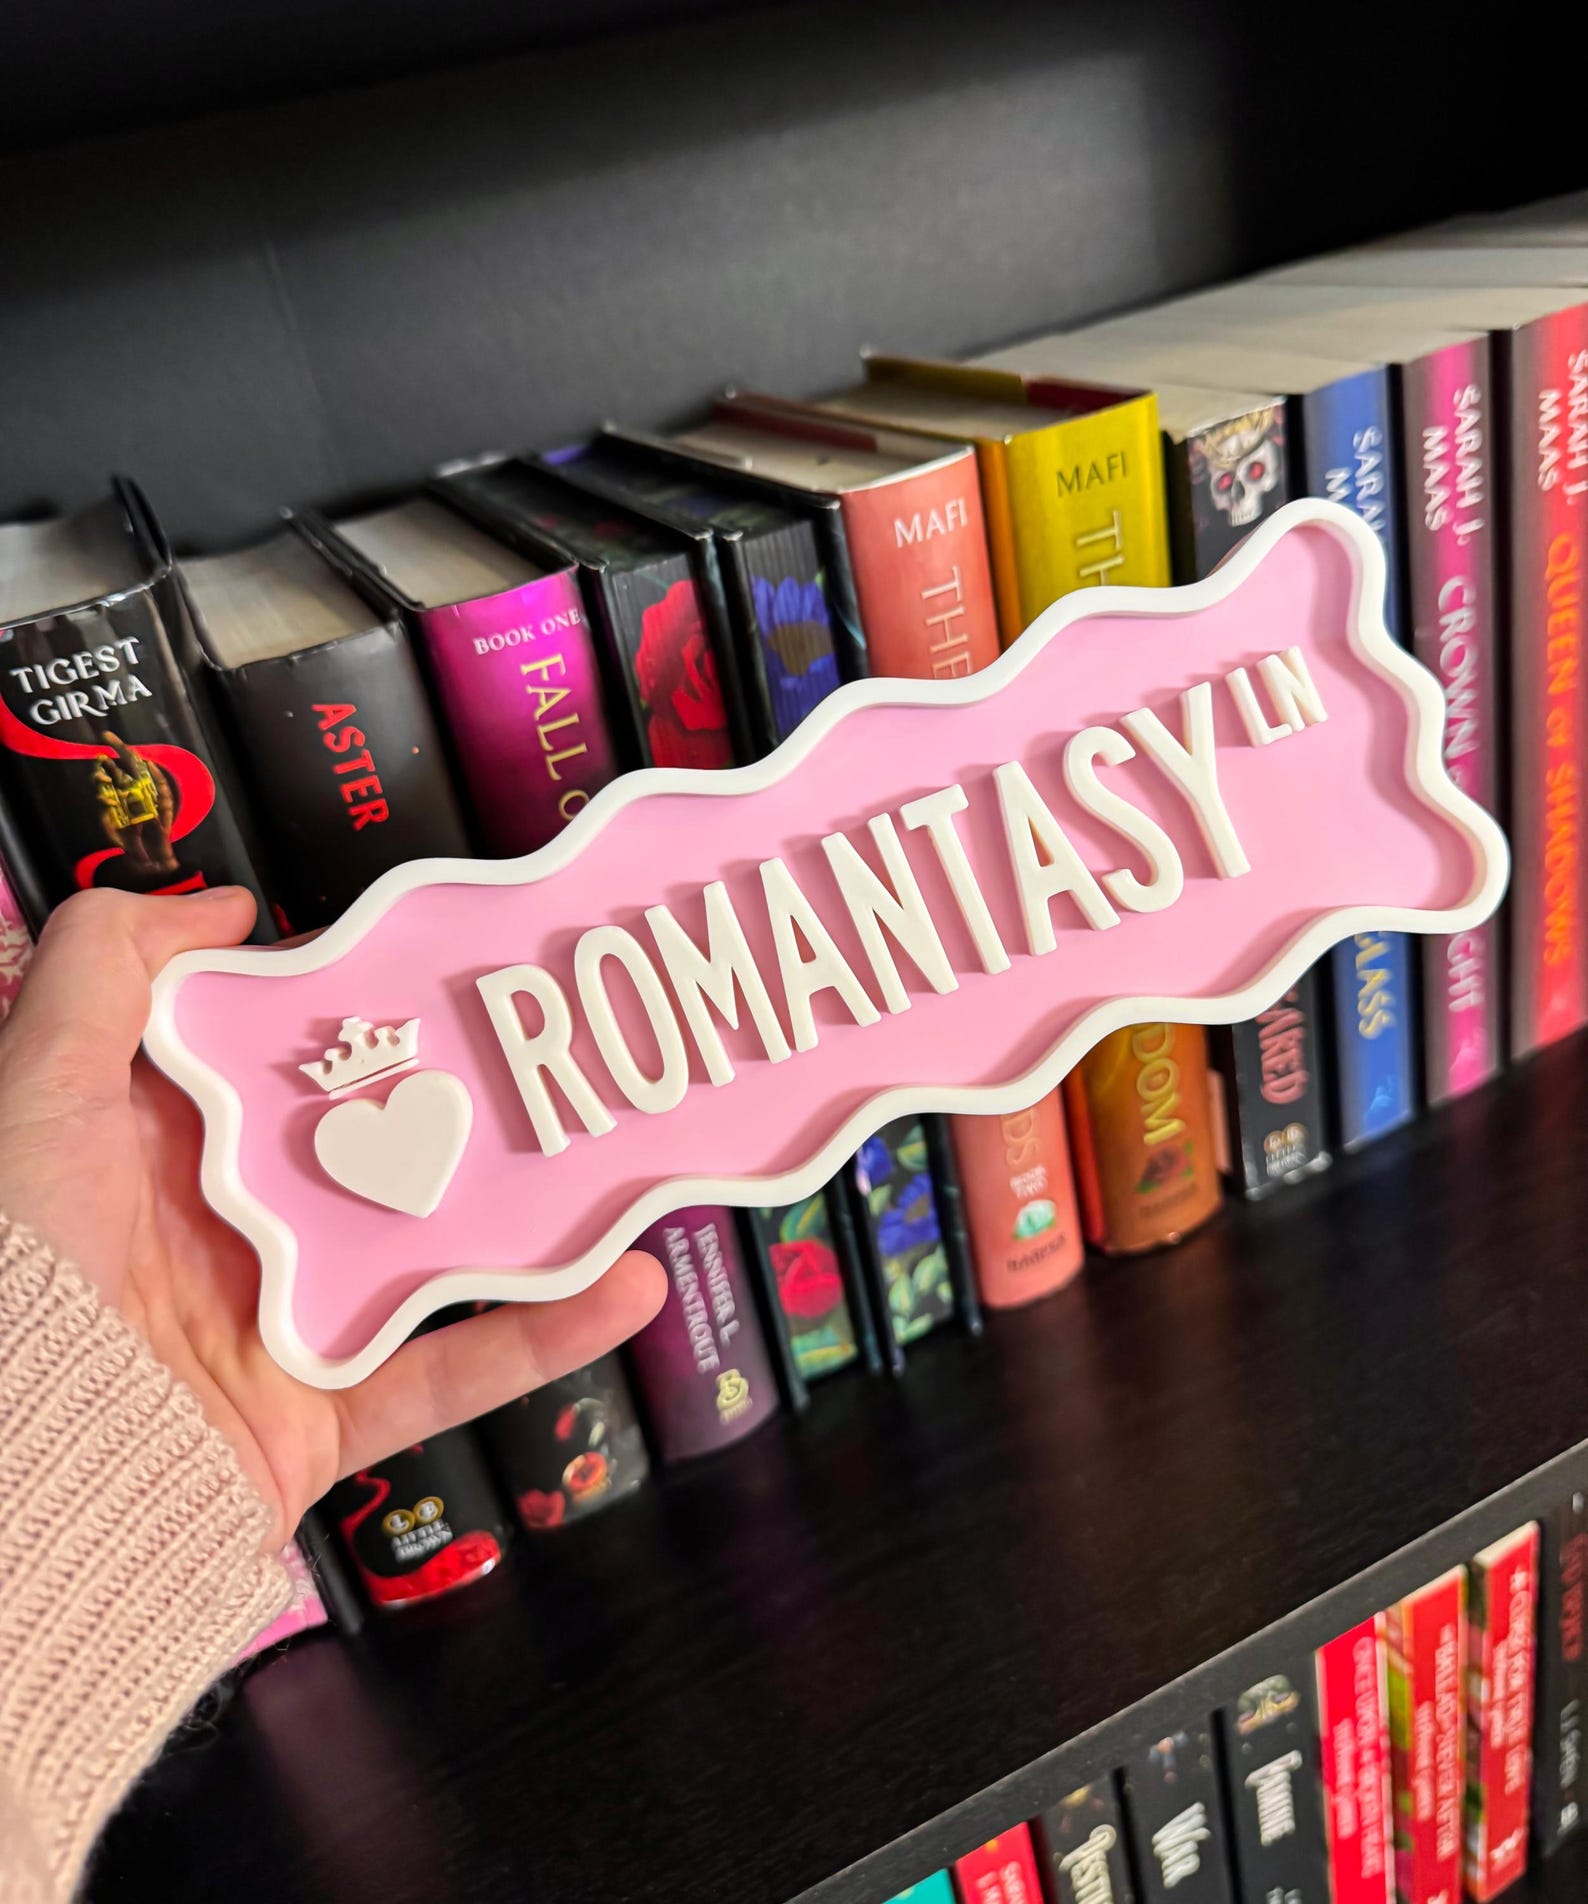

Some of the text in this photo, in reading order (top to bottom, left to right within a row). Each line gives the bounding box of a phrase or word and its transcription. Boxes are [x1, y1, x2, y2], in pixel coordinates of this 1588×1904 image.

[1056, 450, 1127, 497] MAFI
[1423, 425, 1450, 530] MAAS
[1453, 384, 1484, 507] SARAH
[1537, 388, 1562, 491] MAAS
[893, 496, 968, 548] MAFI
[1075, 510, 1124, 586] TH
[10, 635, 141, 694] TIGEST
[473, 608, 582, 655] BOOK ONE
[1545, 532, 1580, 695] QUEEN
[29, 675, 153, 727] GIRMA
[1438, 575, 1478, 759] CROWN
[311, 703, 391, 831] ASTER
[520, 653, 590, 822] FALL O
[477, 646, 1329, 1157] ROMANTASY LN
[1132, 1024, 1186, 1146] DOM
[1256, 993, 1309, 1105] ARED
[1001, 1109, 1040, 1170] DS
